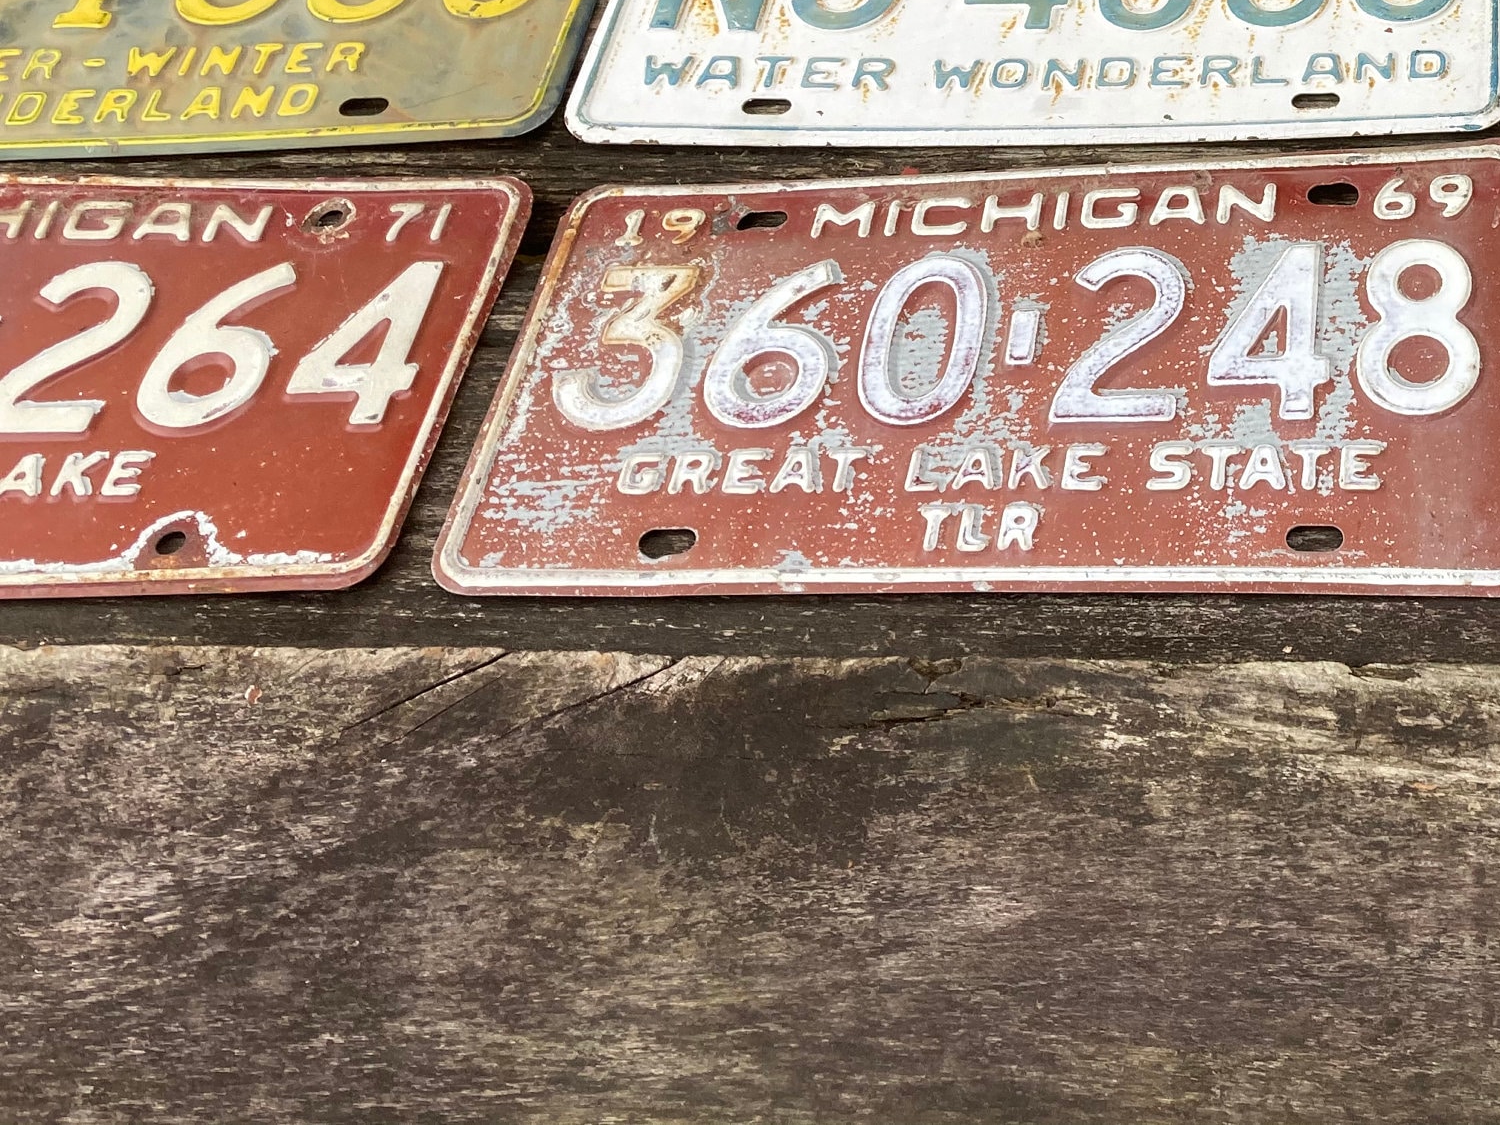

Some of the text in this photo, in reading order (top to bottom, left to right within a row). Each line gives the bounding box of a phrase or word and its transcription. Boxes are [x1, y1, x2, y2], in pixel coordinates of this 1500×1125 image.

[643, 49, 1448, 90] WATER WONDERLAND
[385, 202, 452, 243] 71
[621, 173, 1473, 248] 19 MICHIGAN 69
[616, 441, 1388, 495] GREAT LAKE STATE
[918, 503, 1039, 553] TLR
